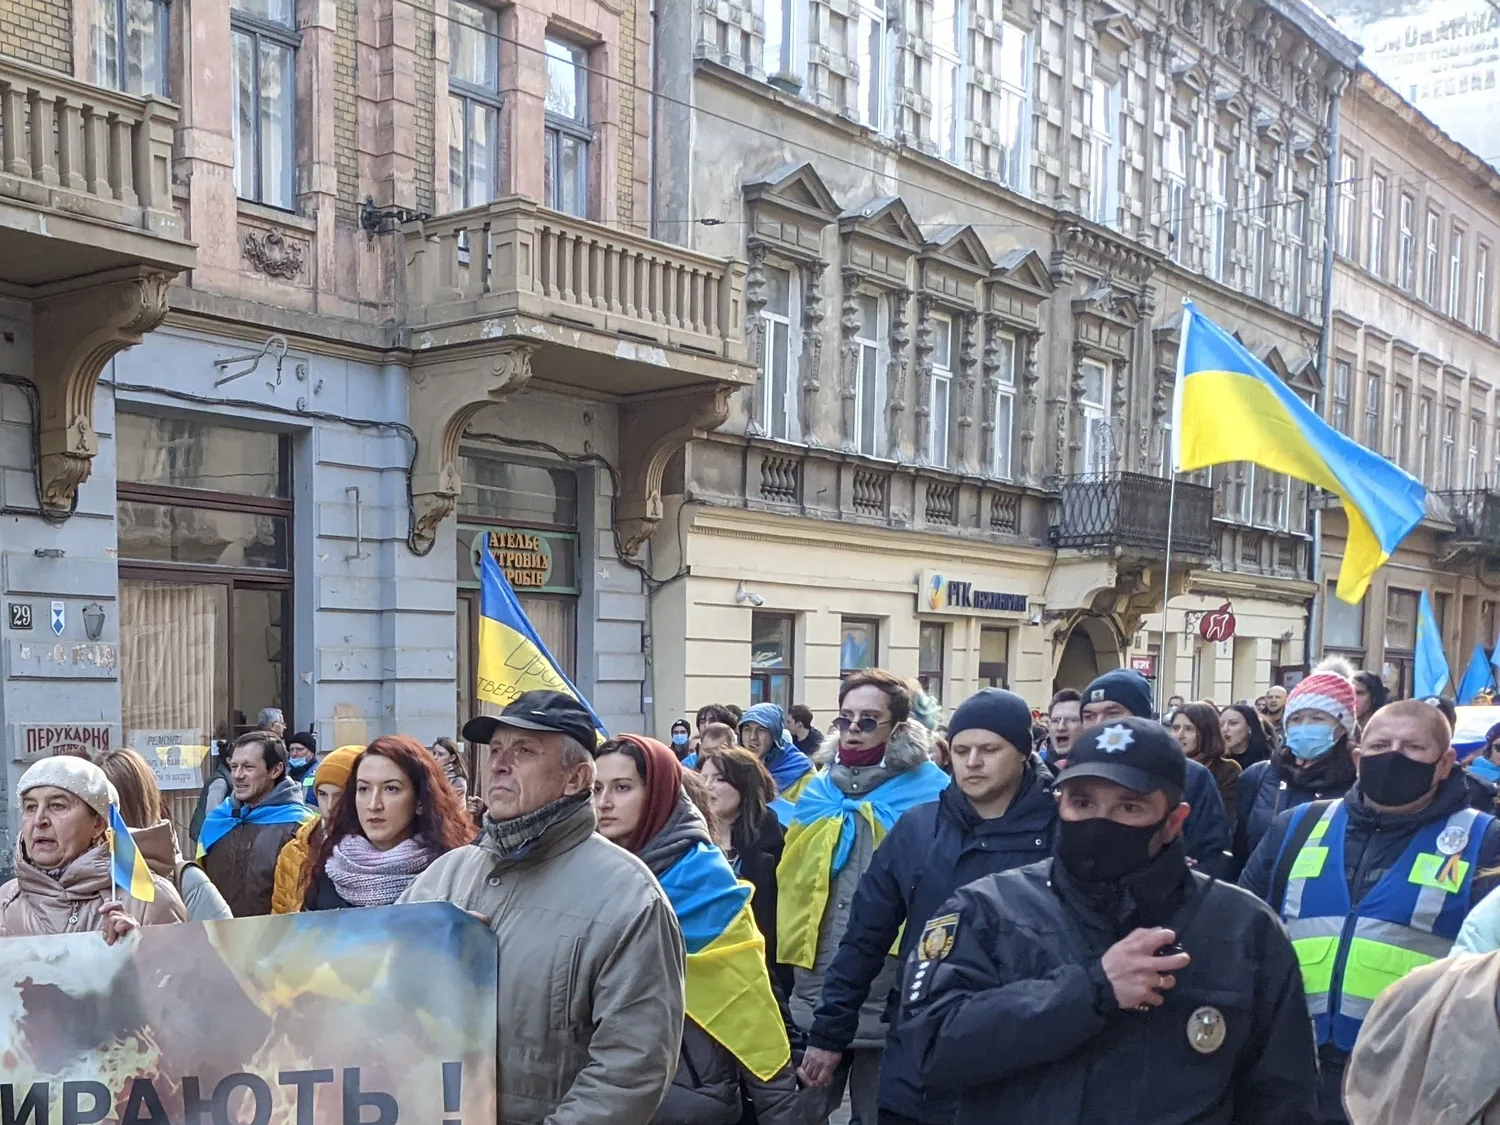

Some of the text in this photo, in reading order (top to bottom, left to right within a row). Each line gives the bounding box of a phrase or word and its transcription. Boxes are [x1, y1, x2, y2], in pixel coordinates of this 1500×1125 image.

[477, 550, 550, 570] ТРОВИХ
[504, 568, 545, 587] РОБІВ
[12, 604, 32, 626] 29
[477, 676, 525, 701] ТВЕРД
[27, 727, 110, 753] ПЕРУКАРНЯ
